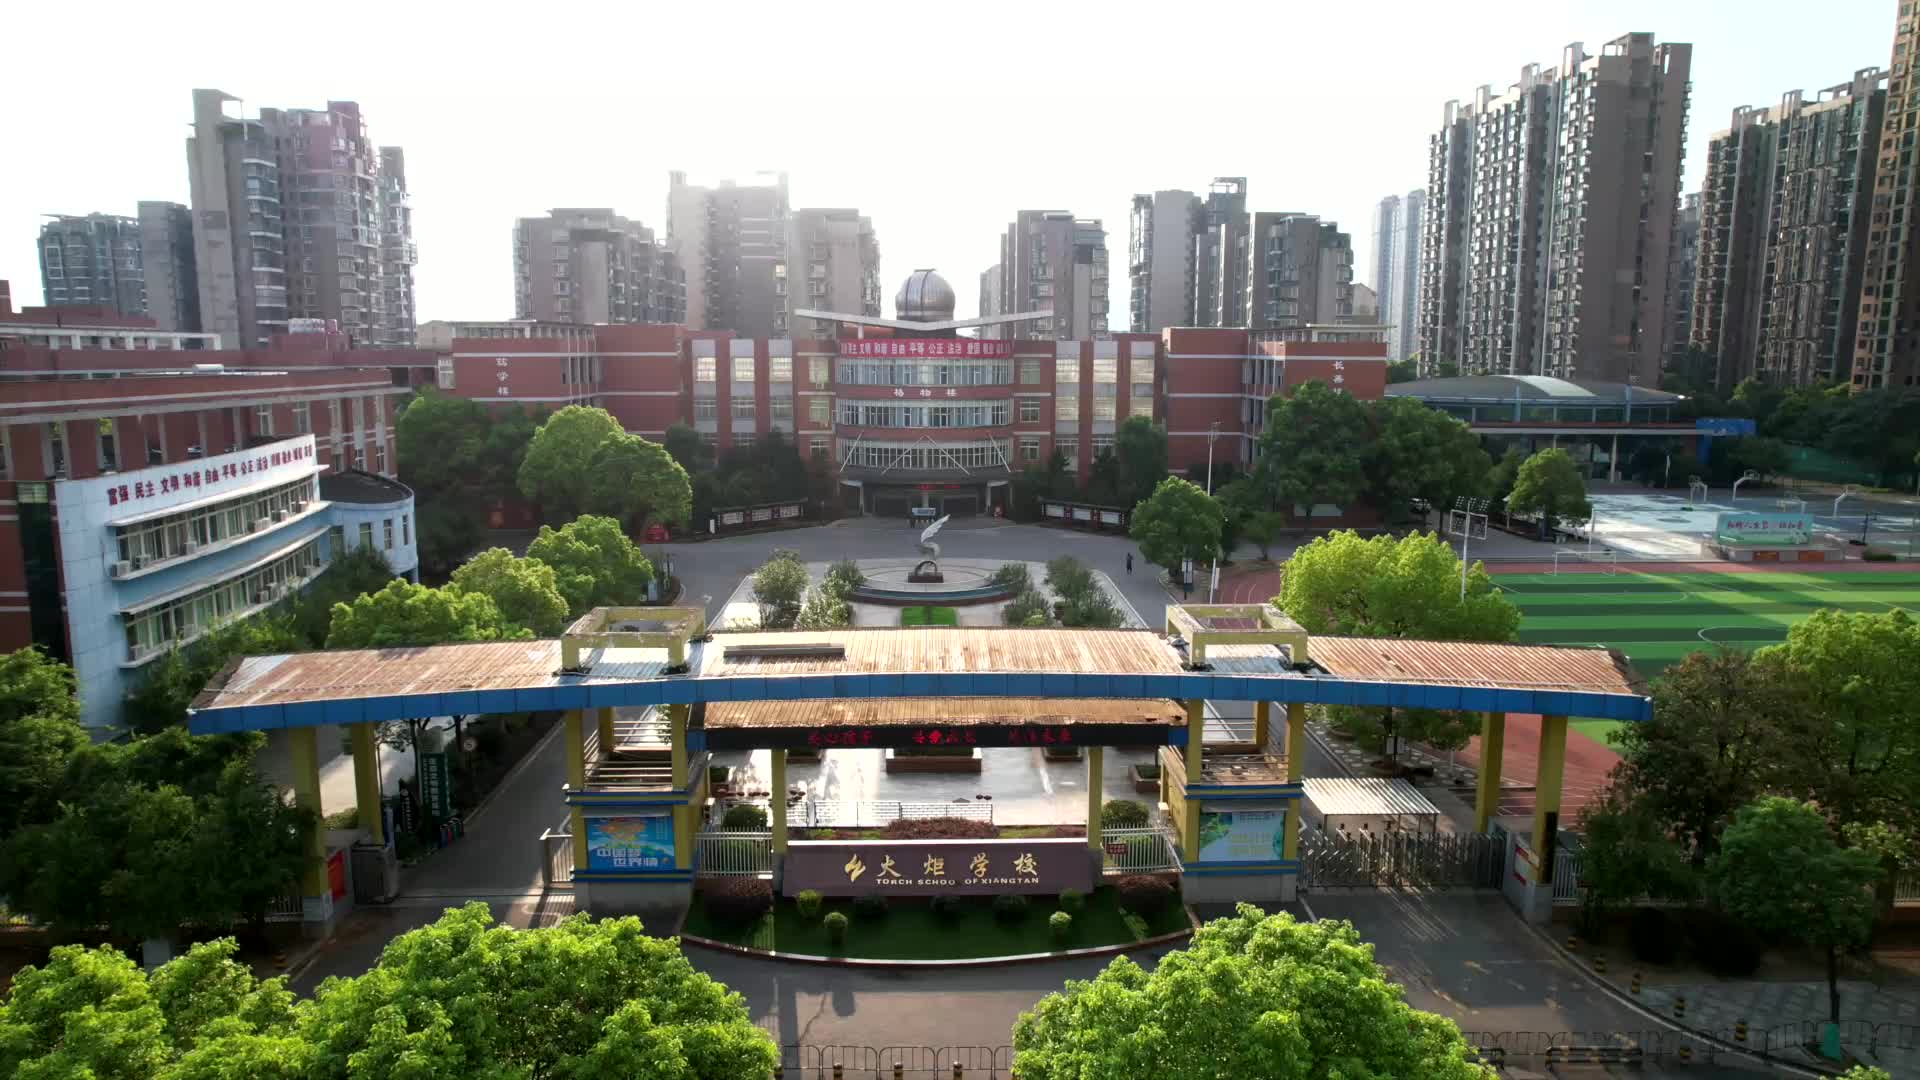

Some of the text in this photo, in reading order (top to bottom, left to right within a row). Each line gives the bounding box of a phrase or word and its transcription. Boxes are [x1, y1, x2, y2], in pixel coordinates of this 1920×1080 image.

[876, 852, 1038, 878] 火炬学校
[981, 877, 1039, 885] XIANGTAN
